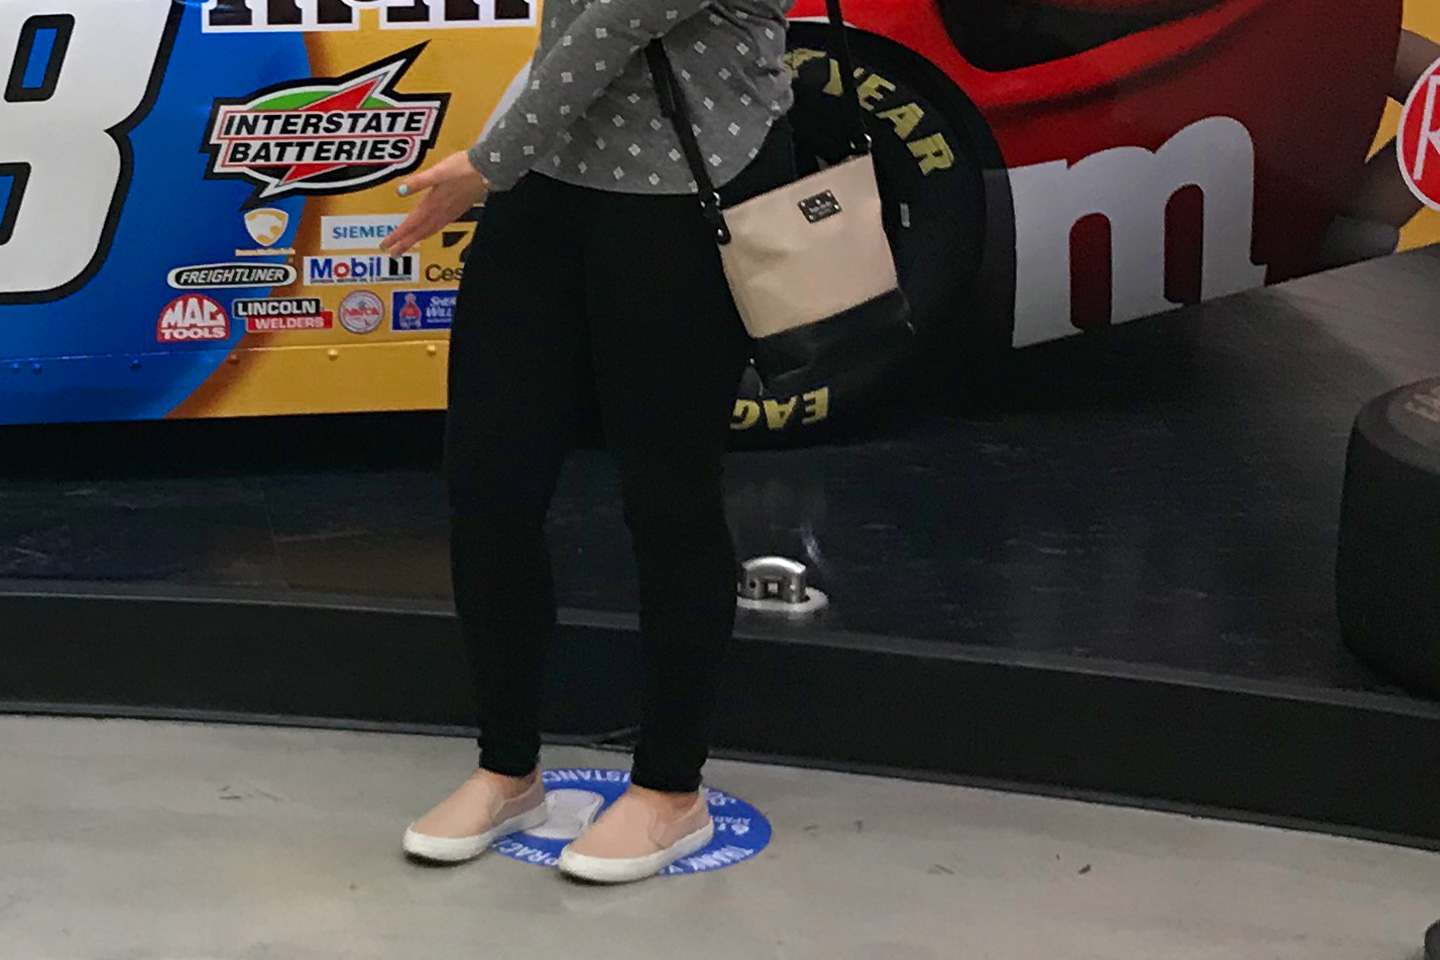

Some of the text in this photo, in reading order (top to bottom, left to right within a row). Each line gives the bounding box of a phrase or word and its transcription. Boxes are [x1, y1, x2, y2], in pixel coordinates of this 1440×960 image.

[223, 110, 427, 137] INTERSTATE
[228, 138, 411, 163] BATTERIES
[332, 225, 399, 240] SIEMEN
[1010, 115, 1268, 349] m
[179, 268, 286, 285] FREIGHTLINER
[310, 256, 382, 279] Mobil
[425, 263, 464, 283] Ces
[160, 296, 227, 327] MAC
[237, 300, 317, 317] LINCOLN
[160, 327, 227, 340] TOOLS
[254, 316, 325, 330] WELDERS
[729, 386, 830, 431] EAG
